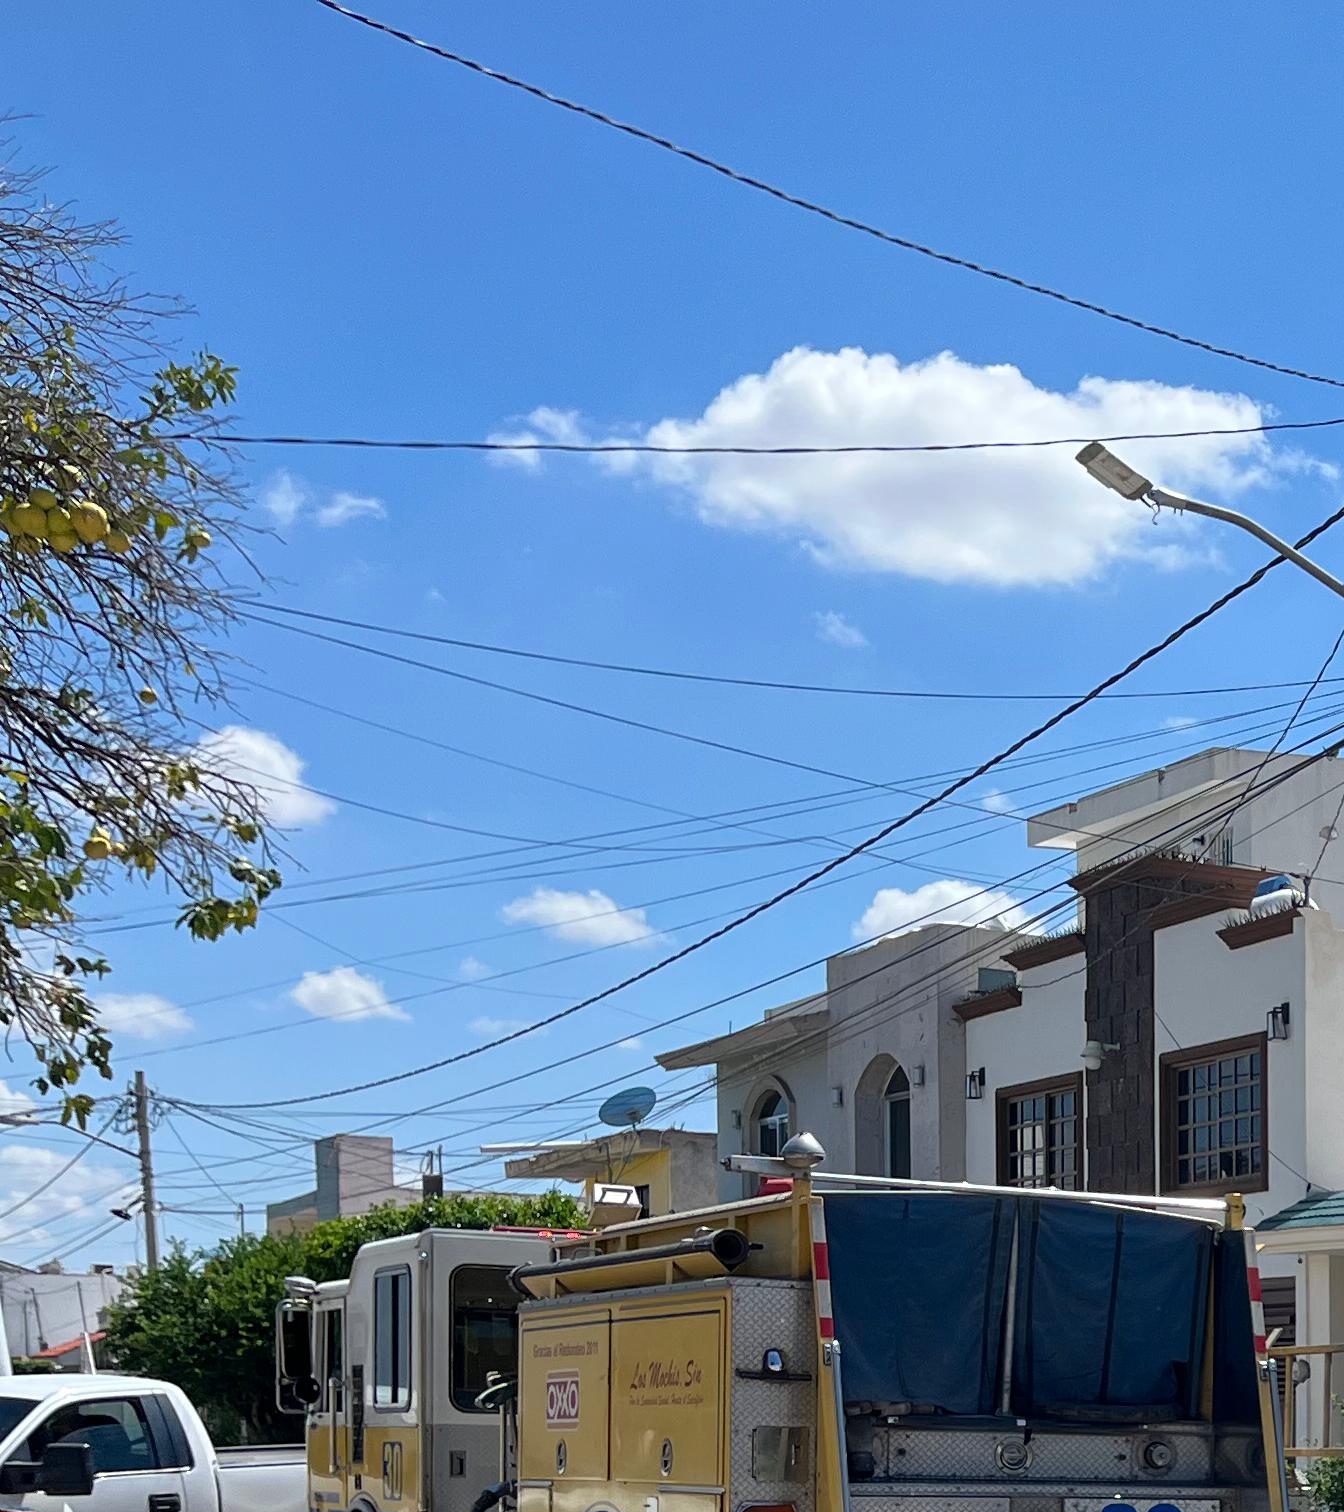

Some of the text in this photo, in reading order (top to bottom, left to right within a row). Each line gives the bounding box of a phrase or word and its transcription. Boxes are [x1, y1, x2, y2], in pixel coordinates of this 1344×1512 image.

[630, 1361, 646, 1390] Los
[547, 1380, 579, 1420] OXXO
[383, 1441, 403, 1501] 30
